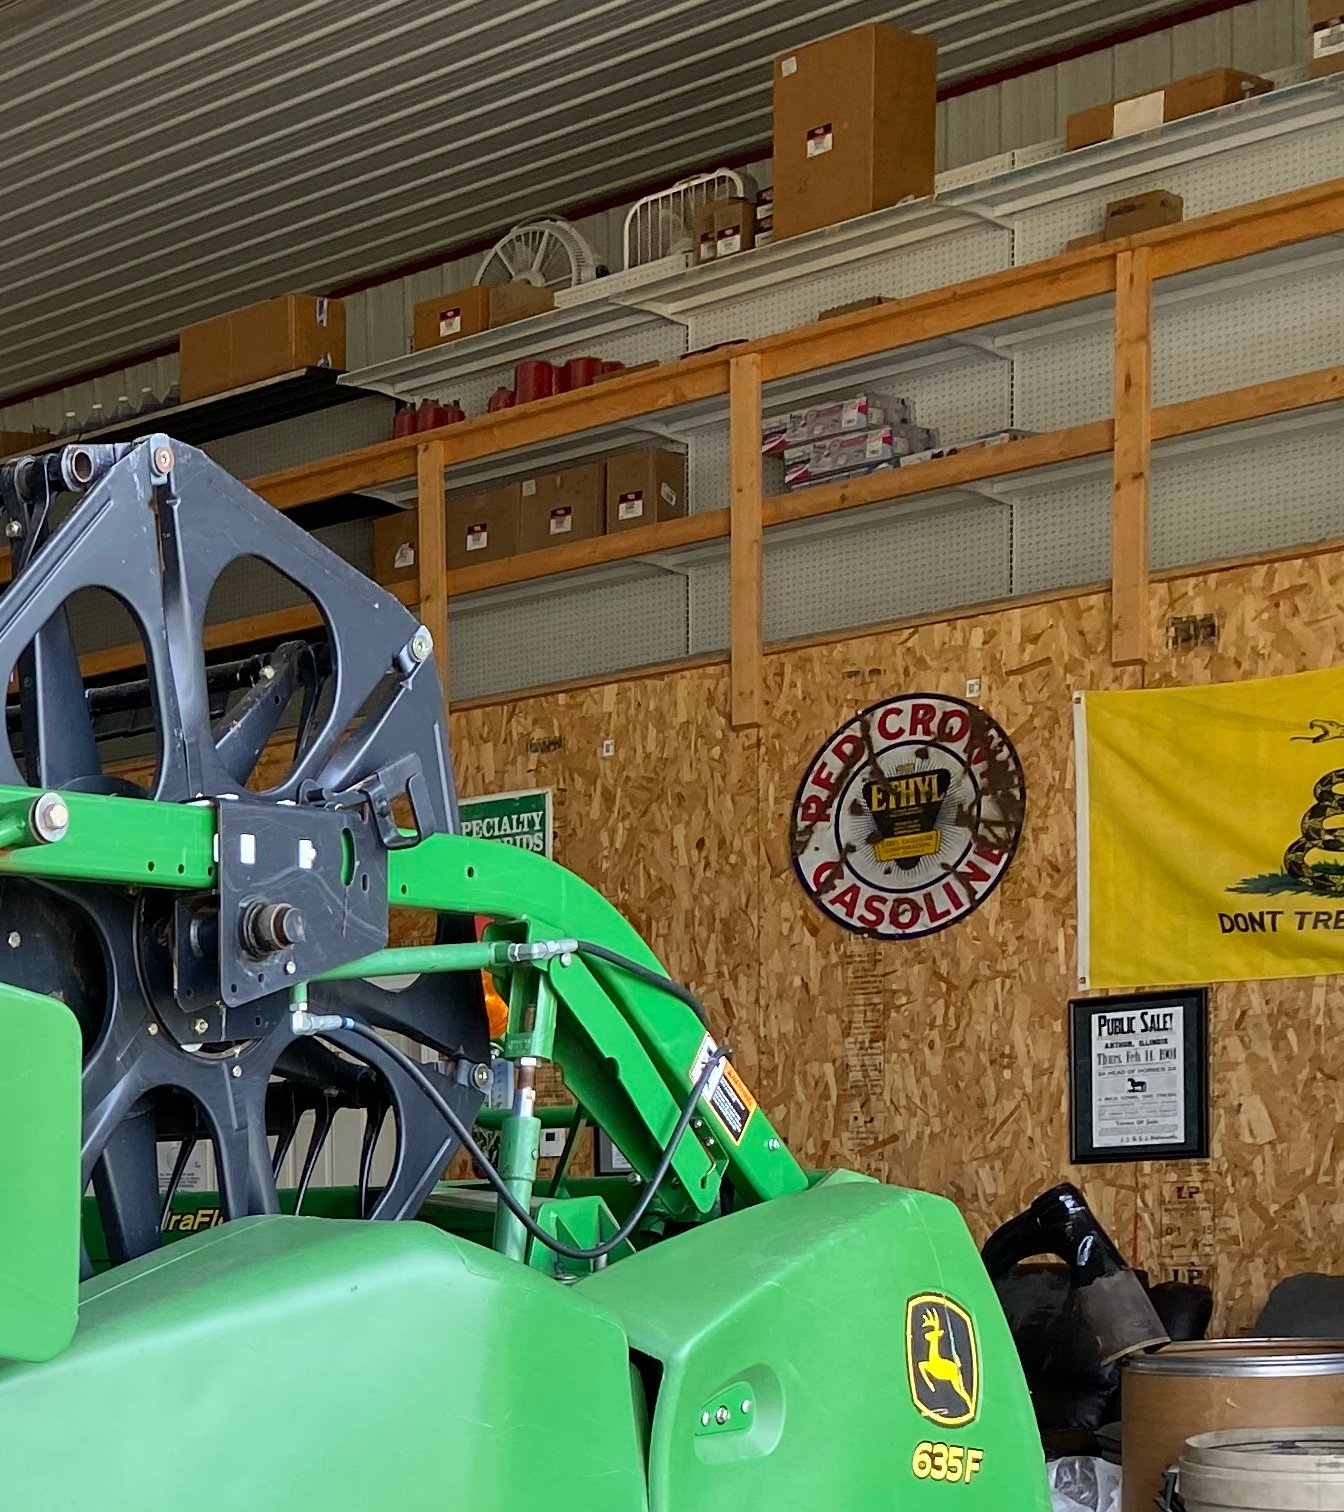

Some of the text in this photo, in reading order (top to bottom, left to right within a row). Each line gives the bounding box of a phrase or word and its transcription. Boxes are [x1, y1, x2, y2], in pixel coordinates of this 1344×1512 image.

[872, 774, 946, 813] ETHYL
[460, 811, 544, 838] PECIALTY
[1218, 910, 1285, 934] DONT
[1098, 1015, 1136, 1037] PUBLIC
[912, 1440, 984, 1484] 635F
